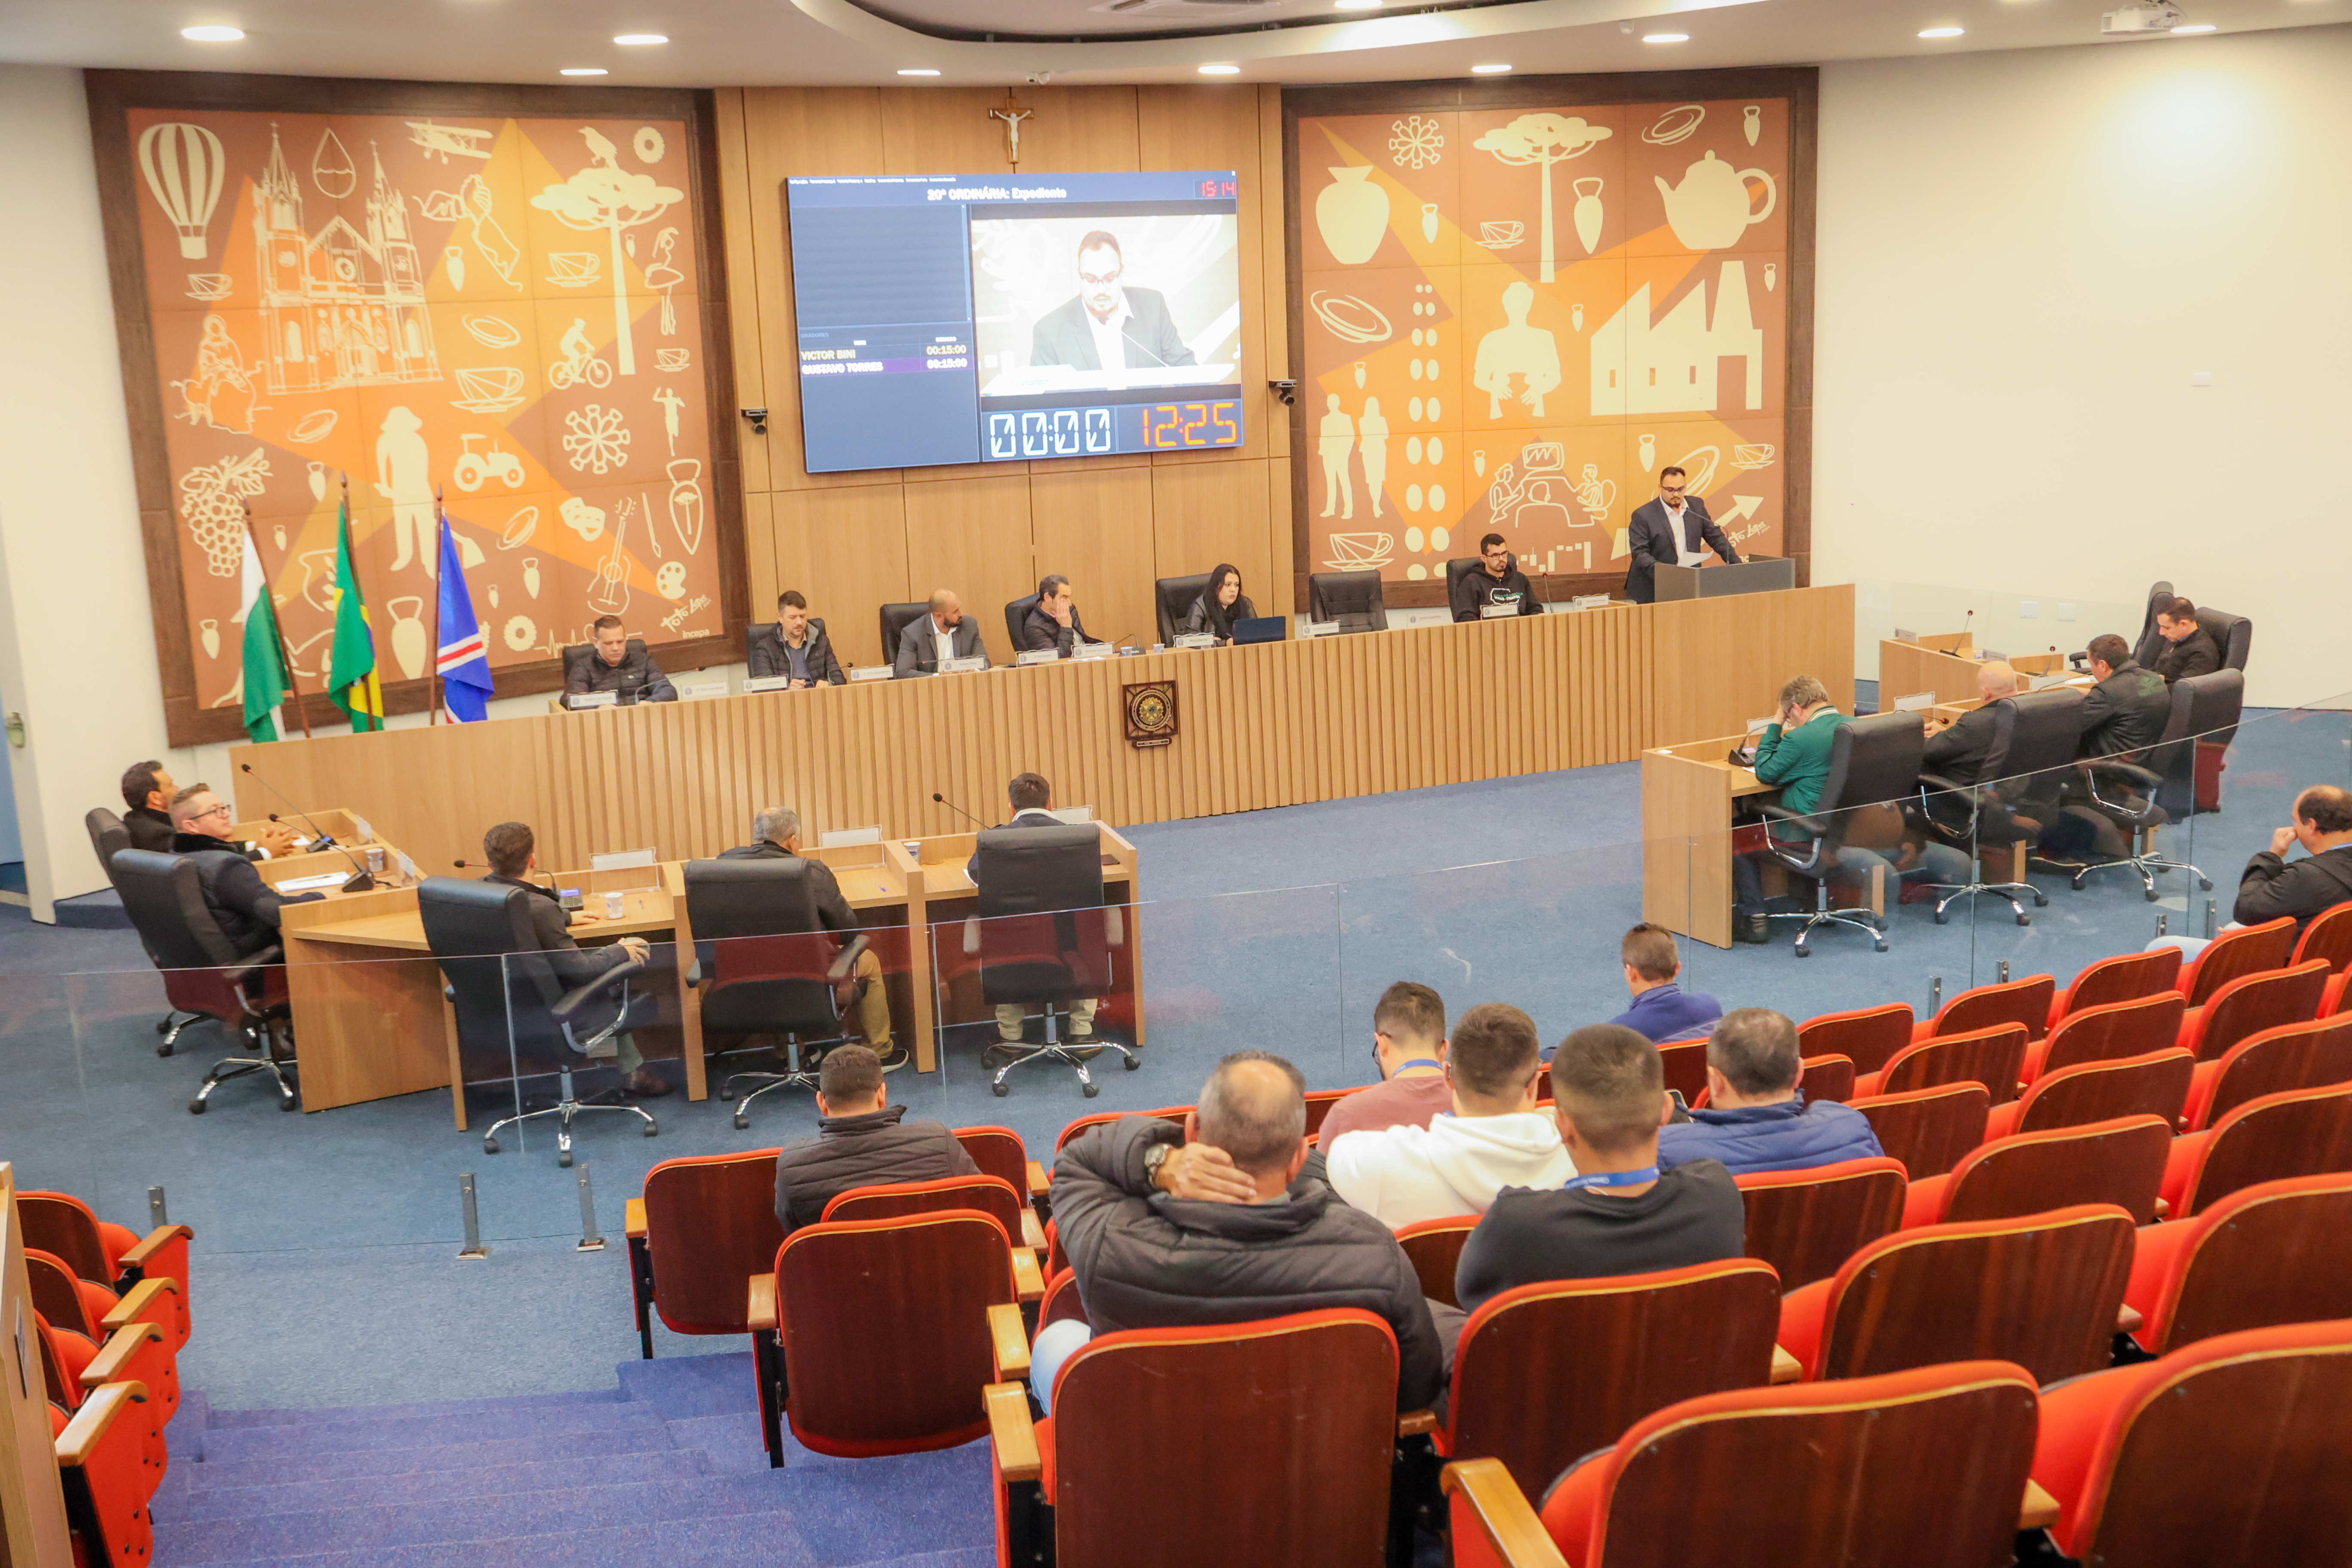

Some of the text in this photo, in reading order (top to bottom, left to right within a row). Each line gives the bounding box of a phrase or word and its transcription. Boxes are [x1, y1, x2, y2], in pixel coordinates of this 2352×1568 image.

[1012, 187, 1067, 201] Expediente
[1201, 181, 1235, 196] 15:14
[801, 349, 856, 360] VICTOR BINI
[926, 345, 967, 355] 00:15:00
[802, 362, 883, 374] GUSTAVO TORRES
[927, 358, 968, 369] 00:15:00
[1142, 402, 1237, 447] 12:25
[682, 628, 710, 639] Incepa
